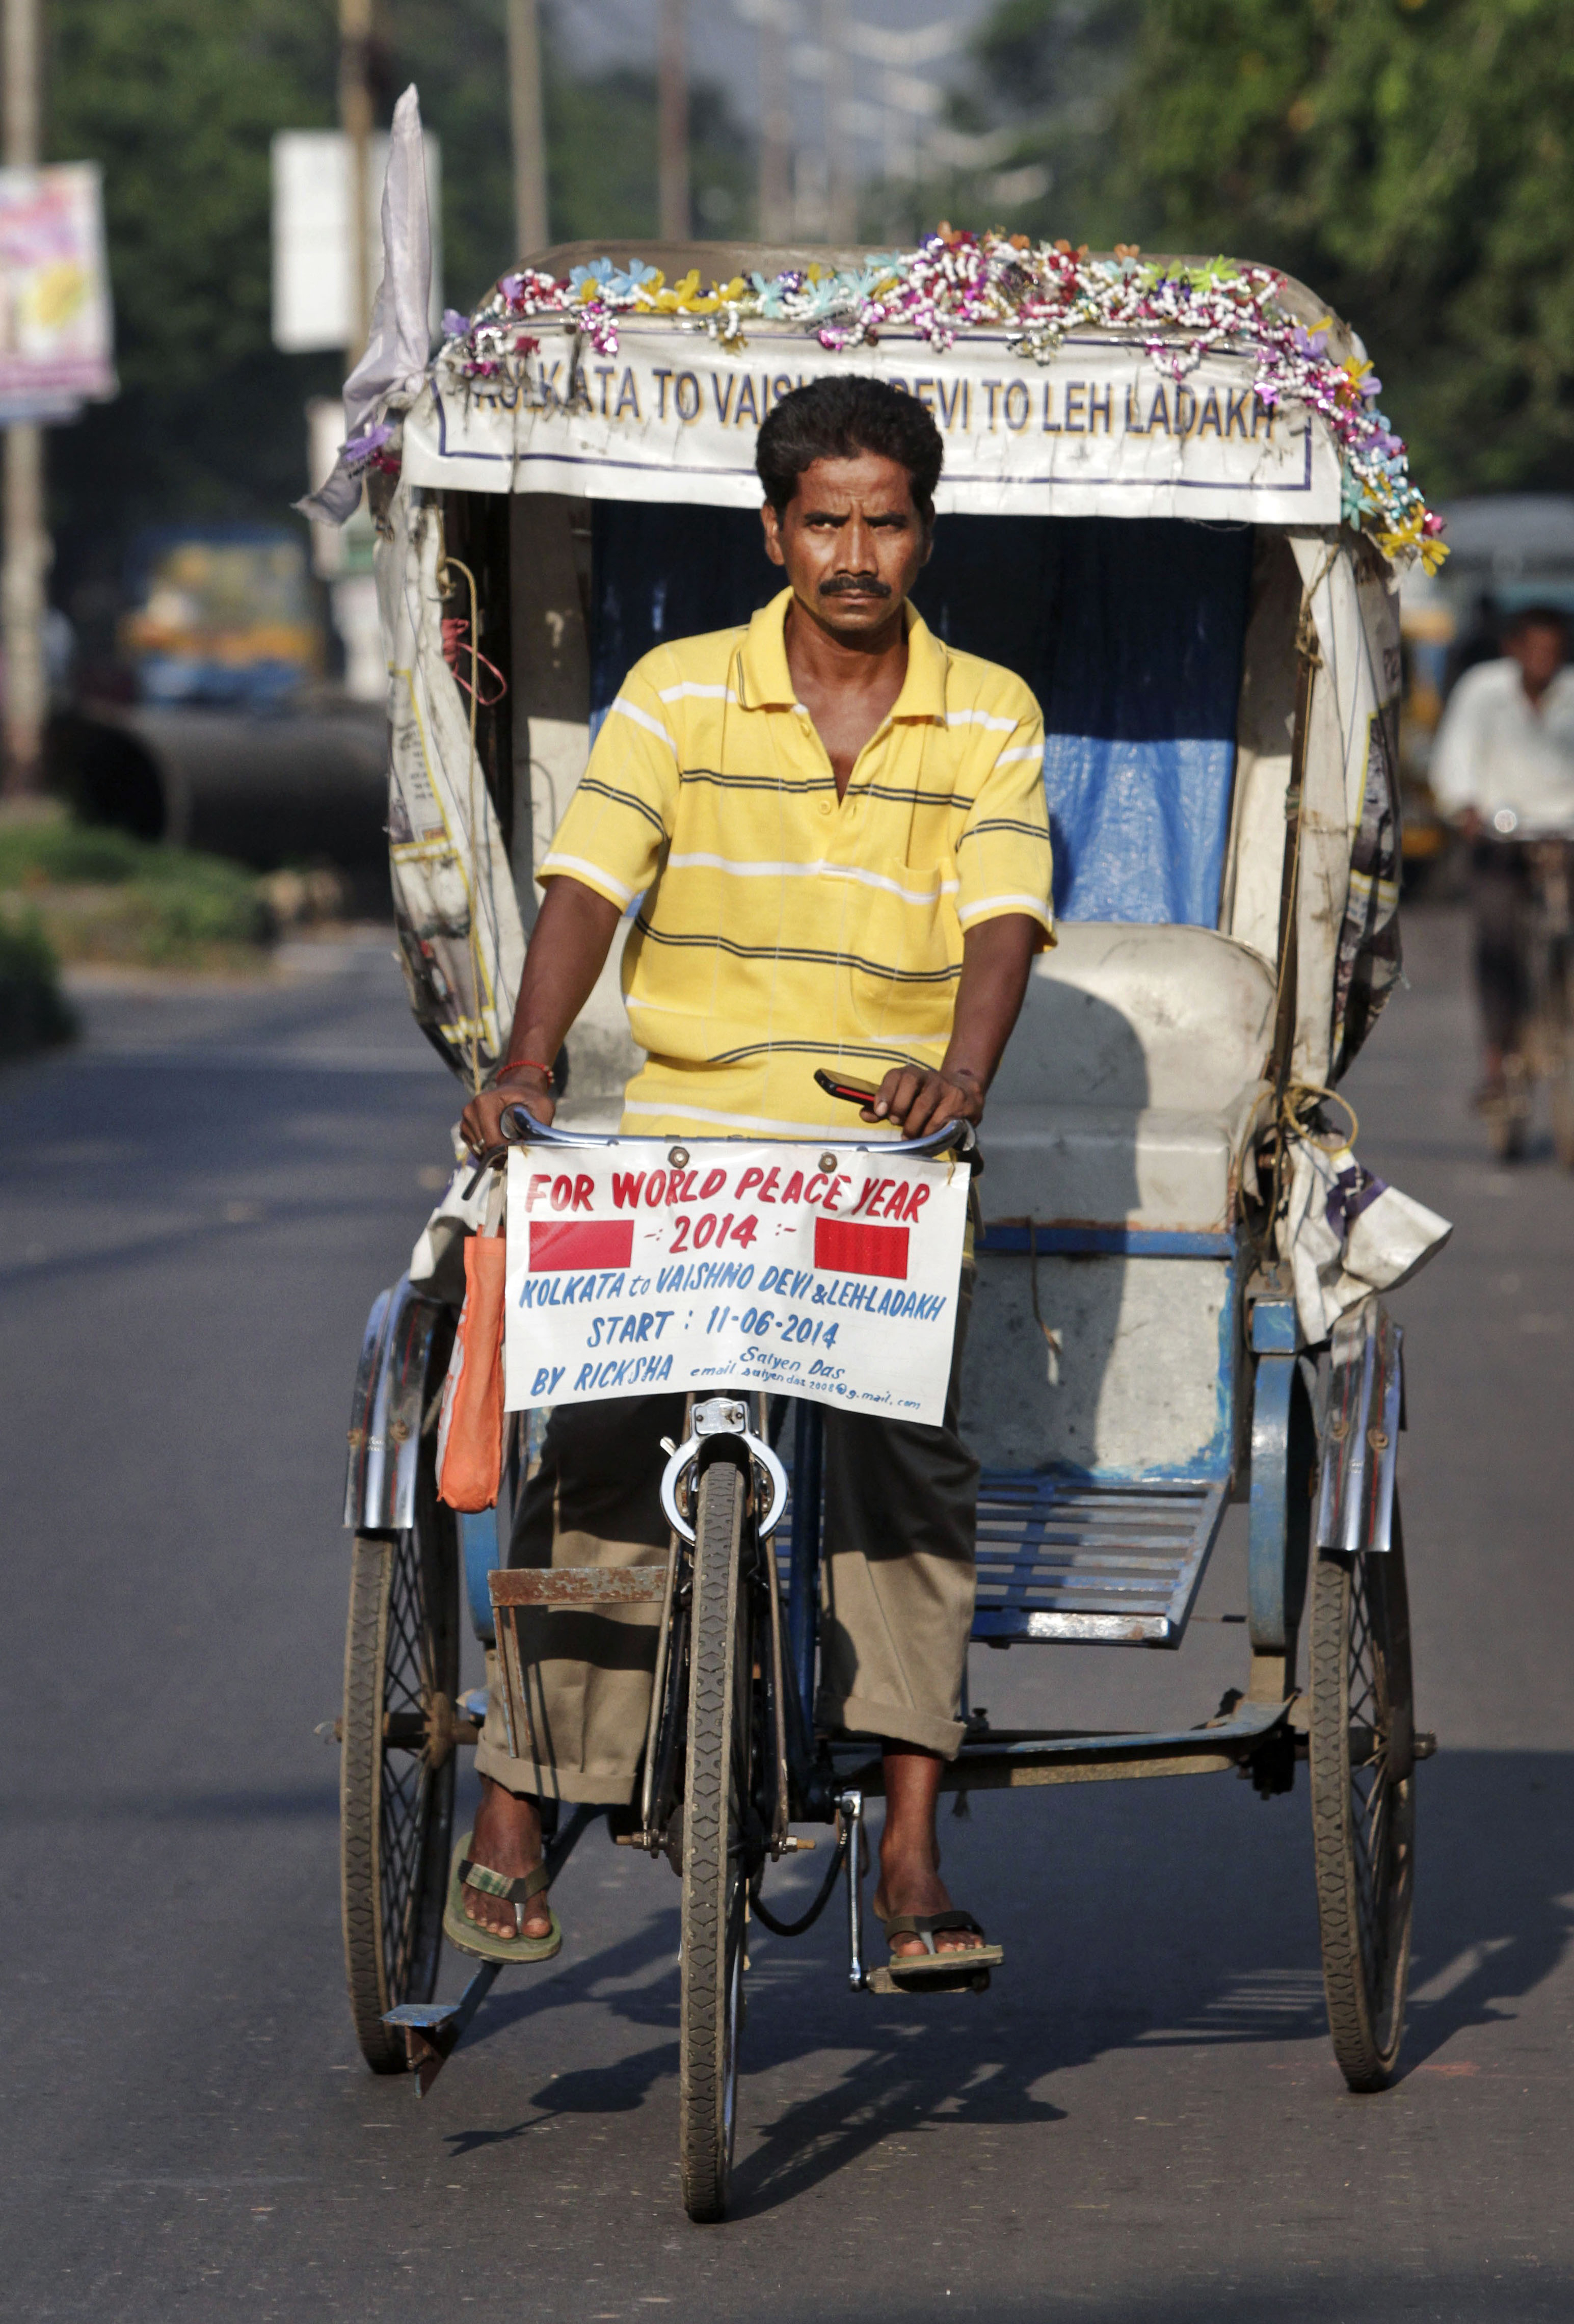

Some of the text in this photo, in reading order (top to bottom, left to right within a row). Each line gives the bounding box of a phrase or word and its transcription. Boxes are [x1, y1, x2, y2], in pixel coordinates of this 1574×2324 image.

[652, 368, 700, 421] TO
[982, 378, 1030, 431] TO
[1043, 381, 1111, 433] LEH
[1125, 383, 1275, 438] LADAKH
[524, 1167, 930, 1223] FOR WORLD PEACE YEAR
[669, 1212, 759, 1254] 2014
[519, 1273, 626, 1308] KOLKATA
[628, 1275, 651, 1297] to
[656, 1261, 755, 1294] VAISHNO
[758, 1265, 814, 1300] DEVI
[586, 1310, 675, 1348] START
[706, 1305, 840, 1350] 11-06-2014
[530, 1354, 674, 1396] BY RICKSHA
[689, 1360, 737, 1377] email
[807, 1359, 846, 1379] Das
